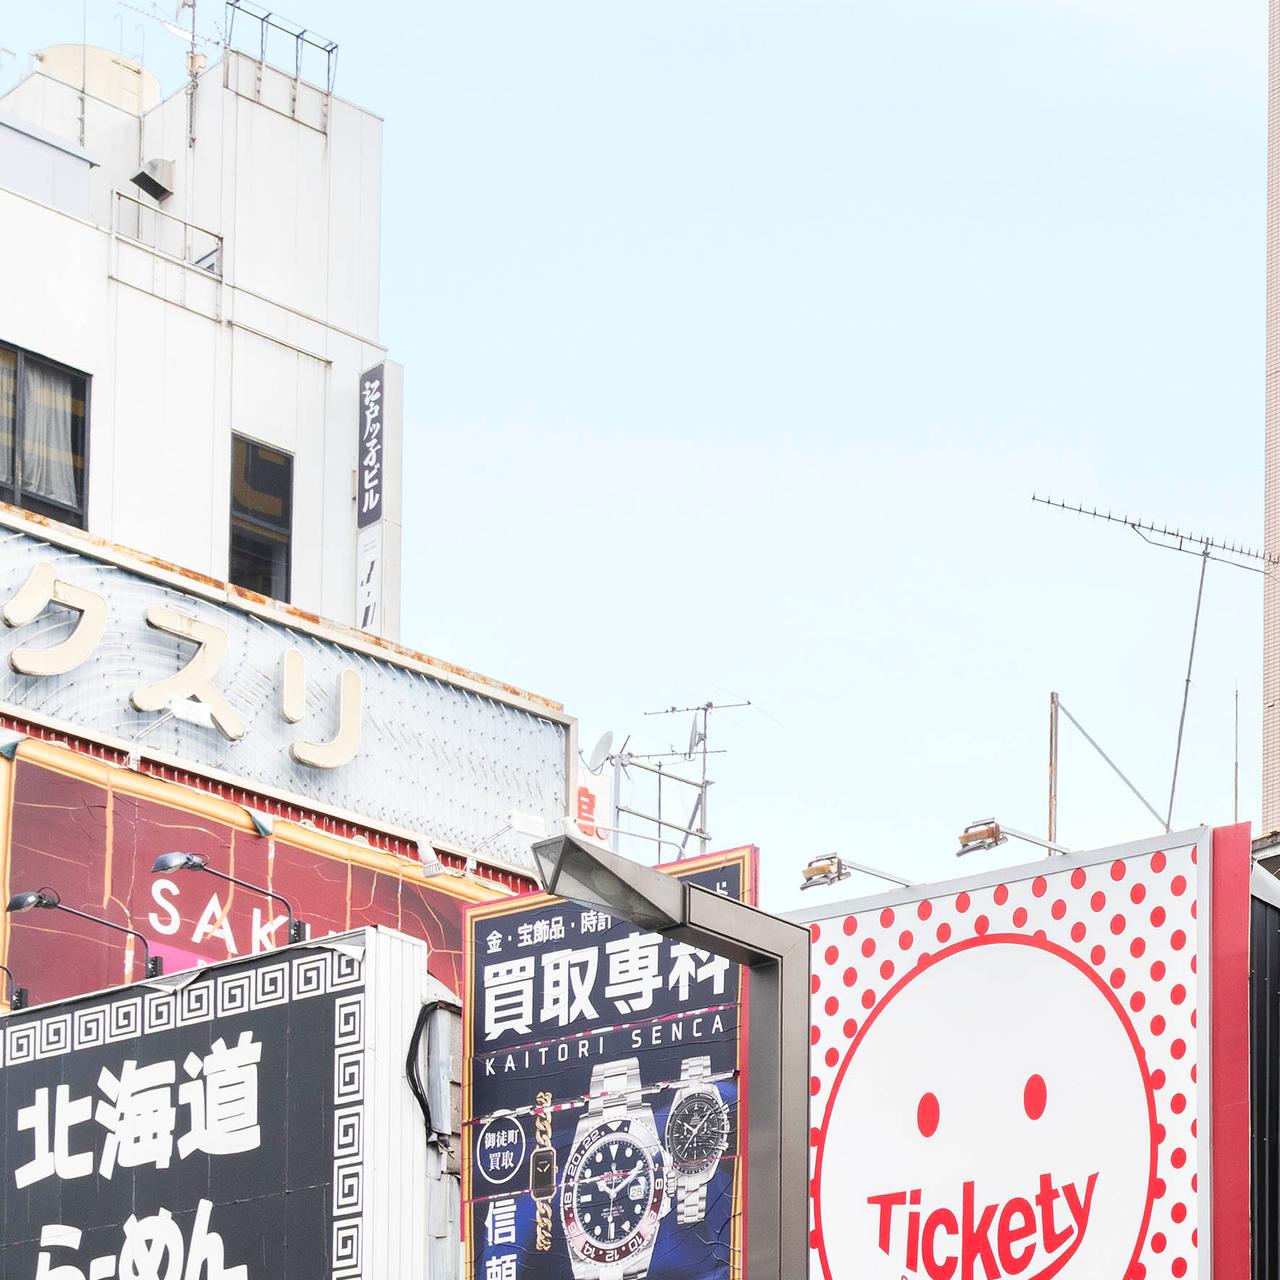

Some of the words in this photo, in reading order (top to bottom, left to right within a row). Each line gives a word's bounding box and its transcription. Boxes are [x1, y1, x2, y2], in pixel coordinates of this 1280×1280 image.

[0, 562, 362, 768] クスリ
[149, 878, 340, 956] SAK
[484, 930, 731, 1042] 買取専科
[485, 1037, 605, 1077] KAITORI
[631, 1014, 725, 1049] SENCA
[15, 1031, 262, 1189] 北海道
[489, 1151, 514, 1172] 買取
